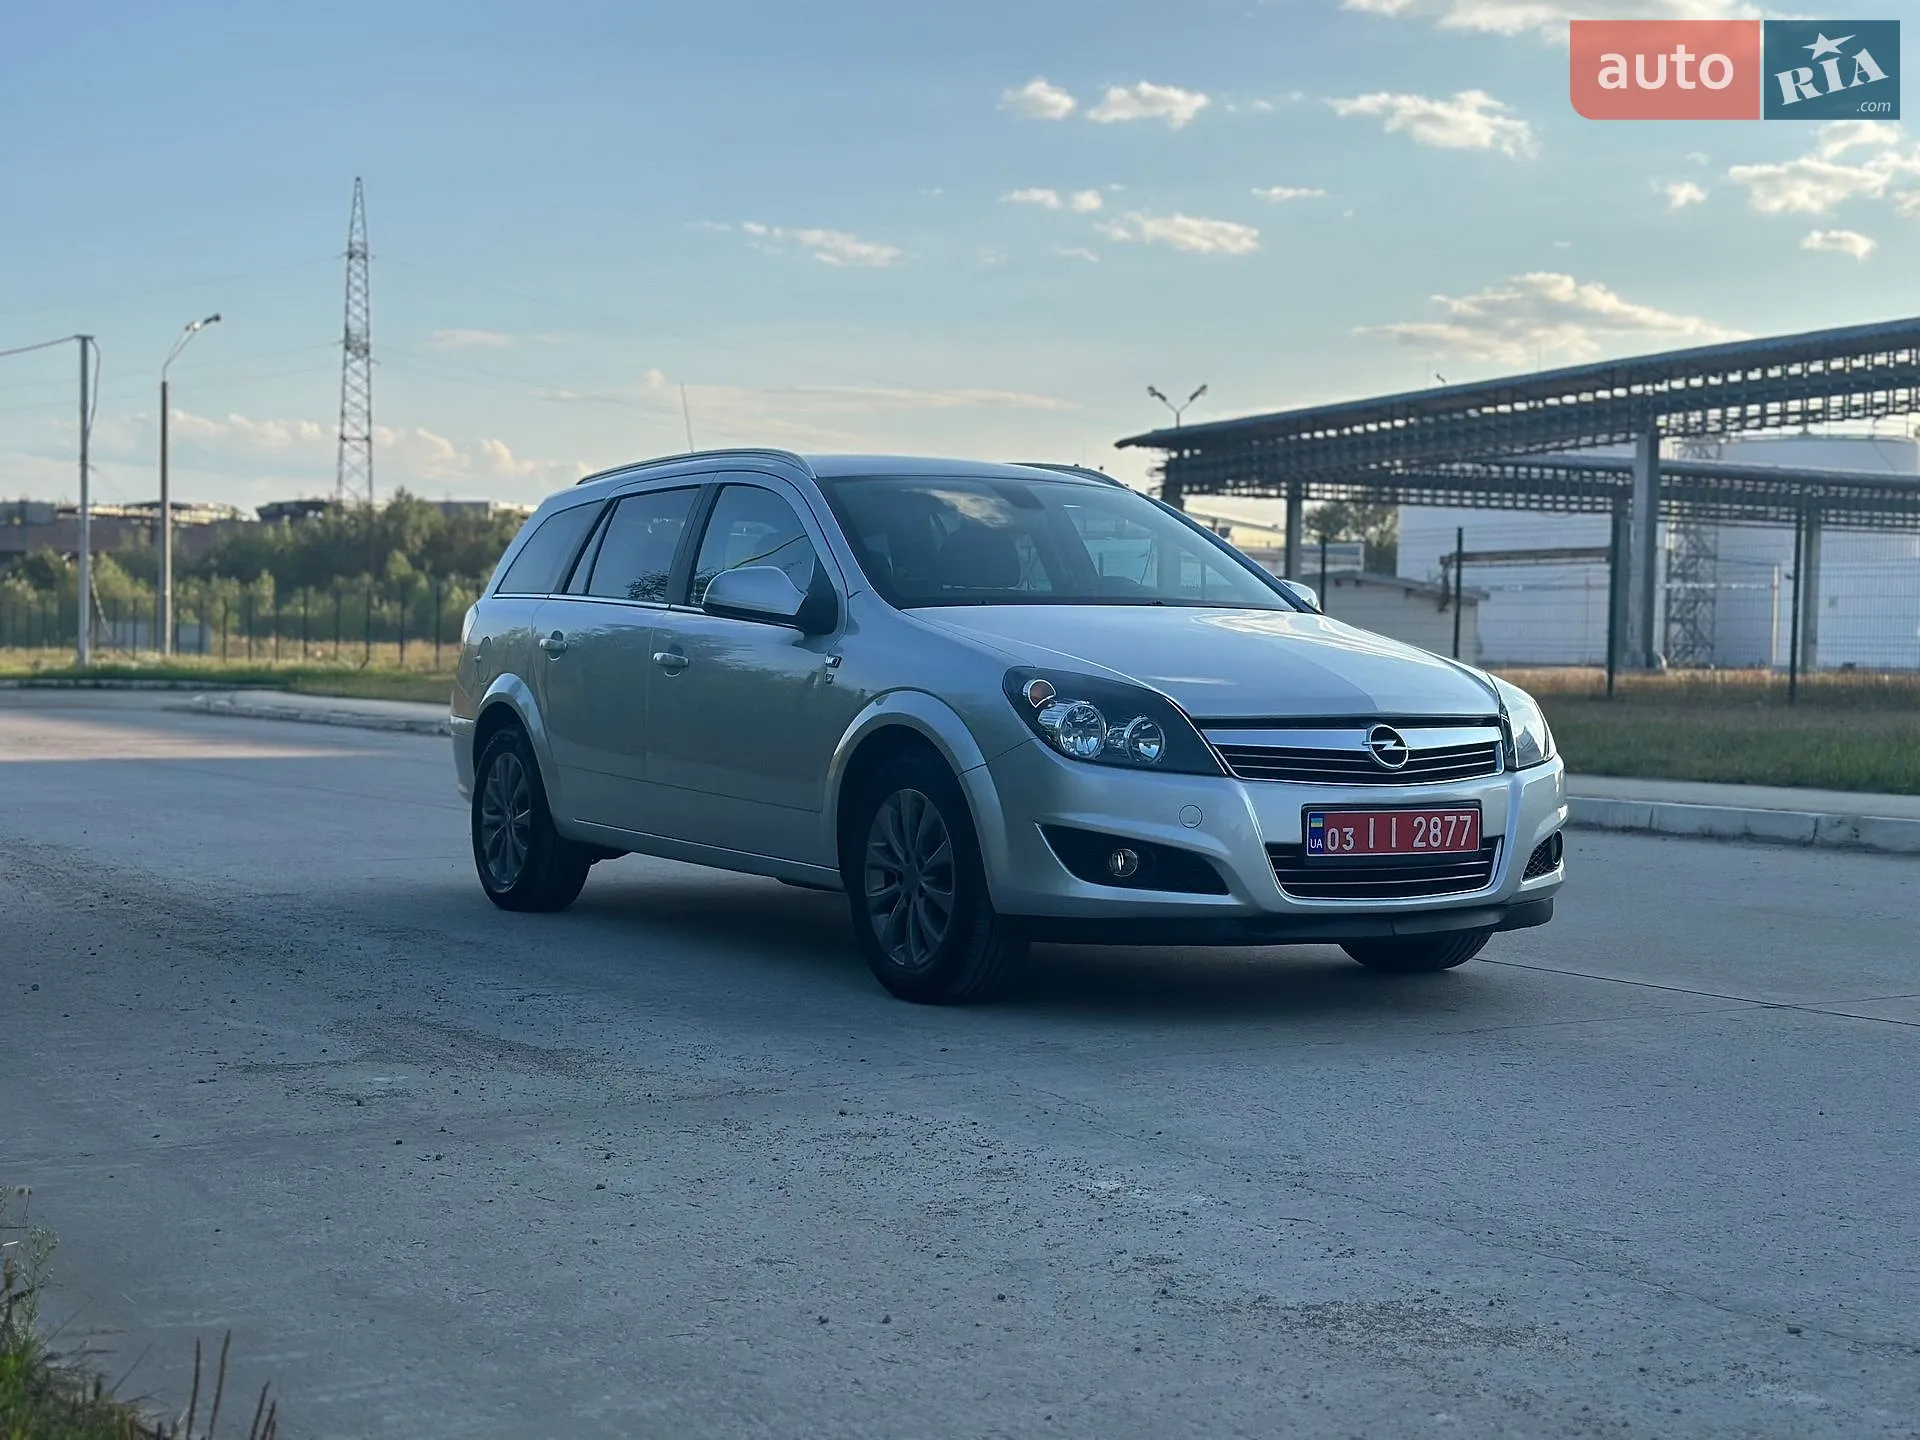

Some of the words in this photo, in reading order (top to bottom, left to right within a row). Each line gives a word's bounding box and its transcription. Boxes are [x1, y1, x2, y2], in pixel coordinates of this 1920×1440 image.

[1310, 838, 1323, 849] UA
[1326, 827, 1355, 851] 03
[1412, 815, 1472, 848] 2877
